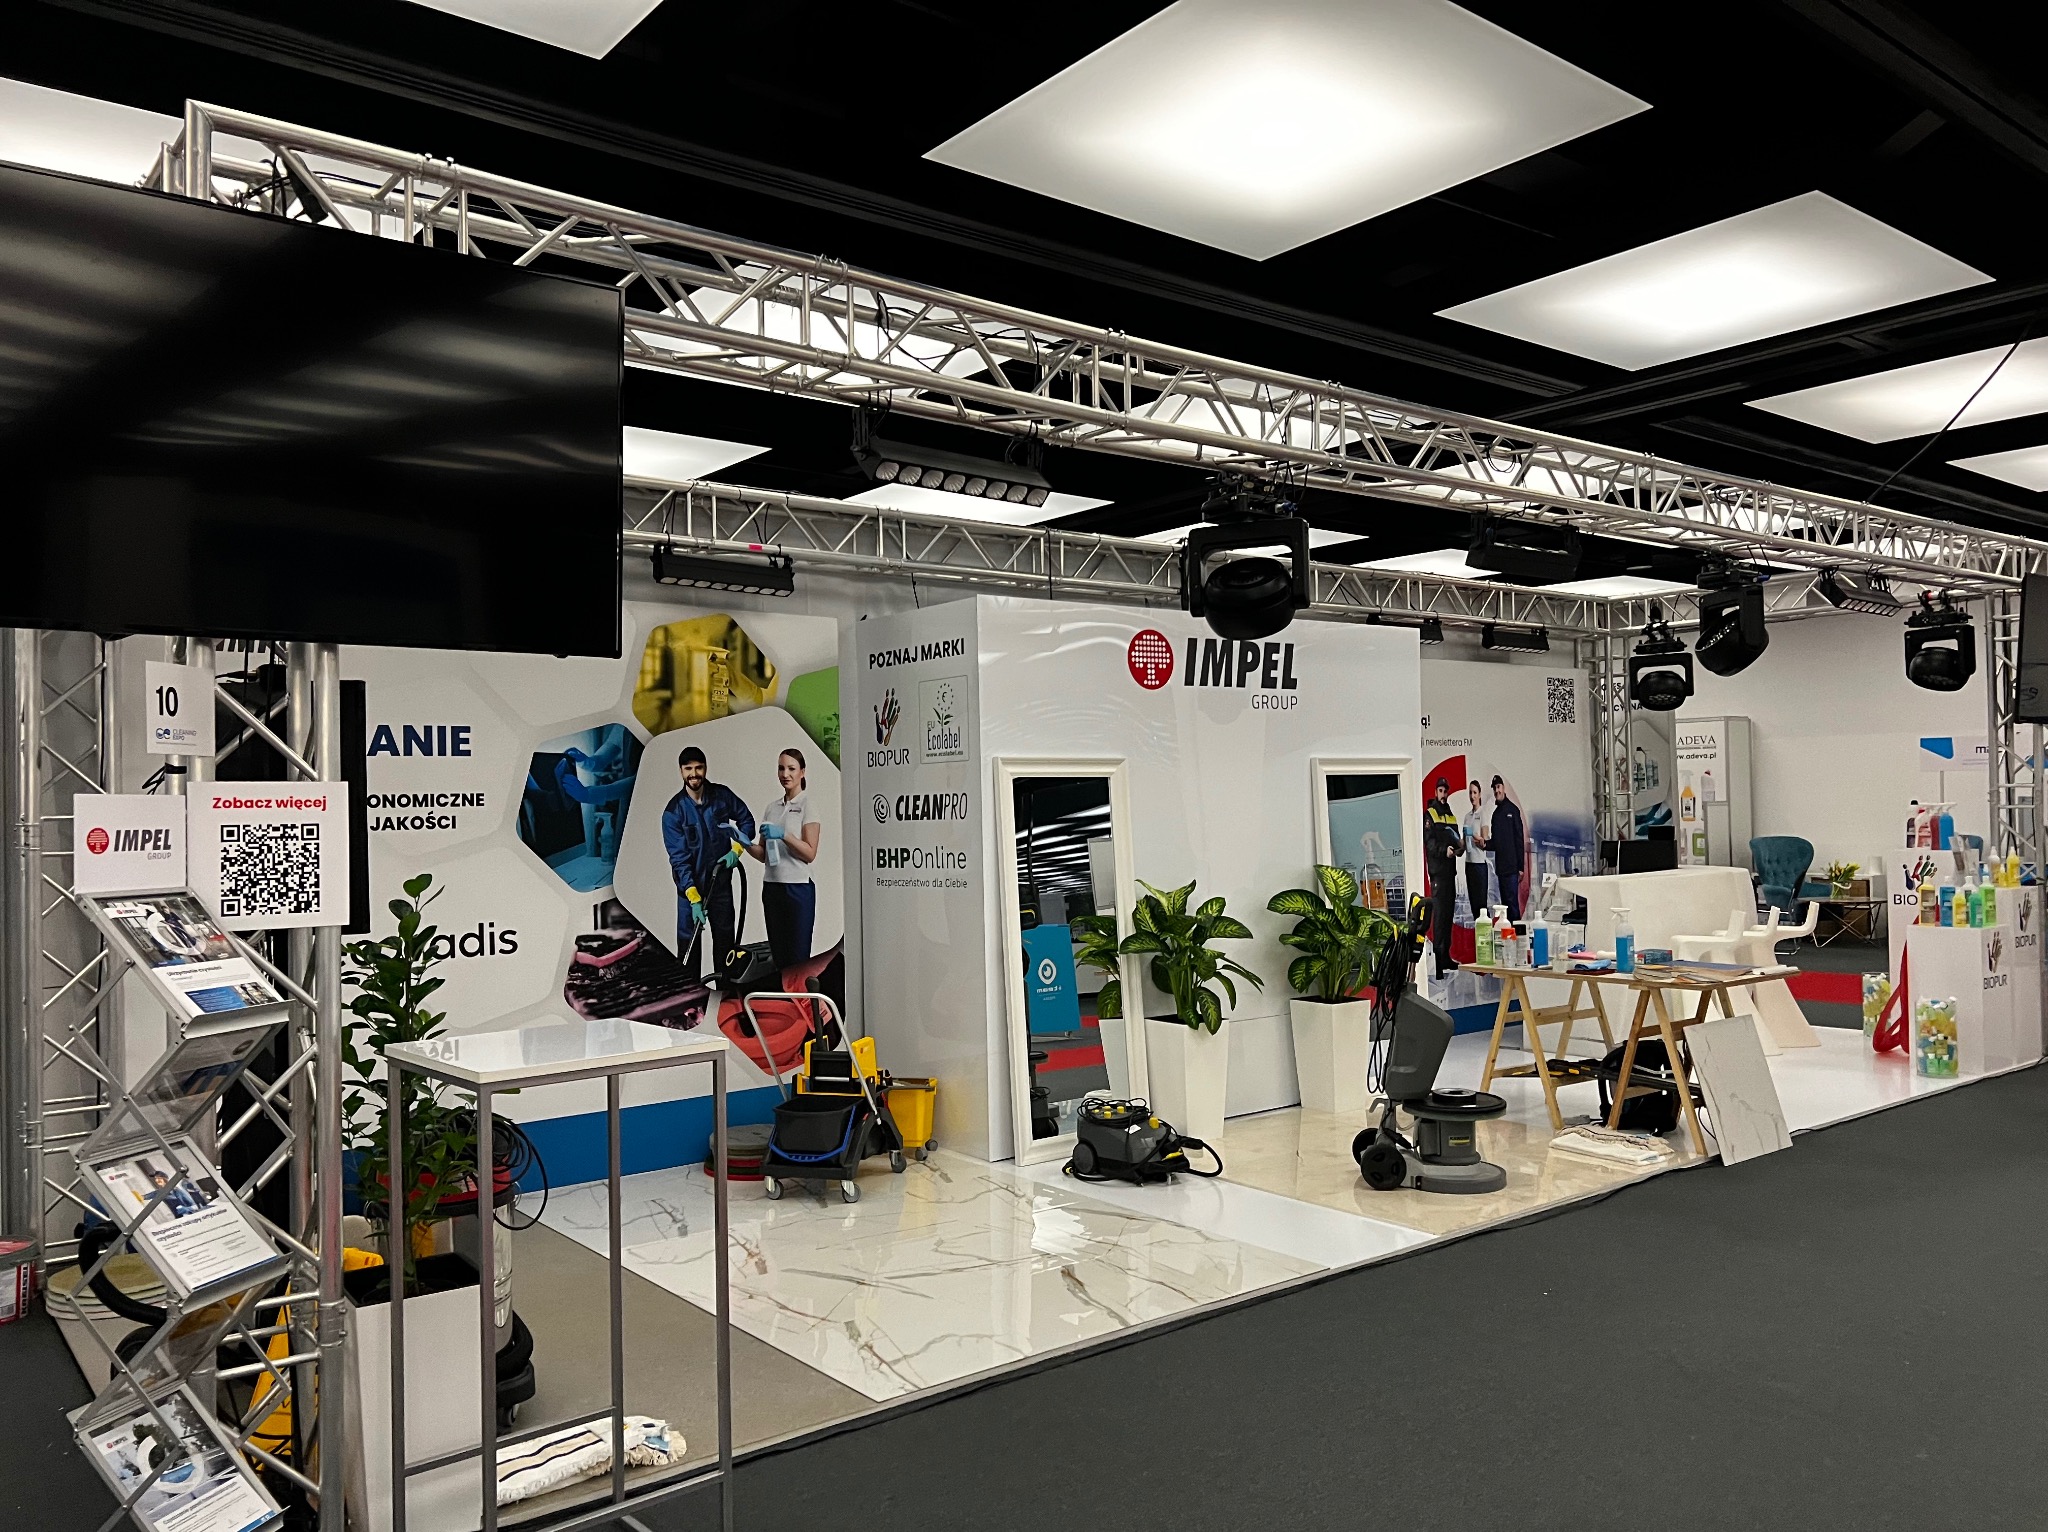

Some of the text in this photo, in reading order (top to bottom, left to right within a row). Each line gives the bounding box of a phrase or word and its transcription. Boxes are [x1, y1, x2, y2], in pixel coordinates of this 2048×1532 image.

[869, 638, 965, 669] POZNAJ MARKI
[1184, 637, 1298, 690] IMPEL
[156, 685, 178, 717] 10
[1251, 694, 1298, 710] GROUP
[927, 720, 935, 729] EU
[366, 724, 472, 757] ANIE
[927, 726, 961, 751] Ecolabel
[1425, 738, 1463, 747] newslettera
[1677, 735, 1717, 746] ADEVA
[867, 748, 910, 768] BIOPUR
[1677, 752, 1717, 760] w.adeva.pl
[212, 796, 327, 811] Zobacz więcej
[366, 793, 485, 809] ONOMICZNE
[895, 792, 968, 821] CLEANPRO
[369, 811, 457, 831] JAKOŚCI
[113, 828, 172, 852] IMPEL
[147, 852, 172, 860] GROUP
[876, 845, 967, 869] BHPOnline
[876, 877, 968, 889] Bezpieczeństwo dla Ciebie
[1893, 893, 1919, 906] BIO
[2015, 934, 2037, 948] BIOPUR
[1983, 974, 2008, 989] BIOPUR
